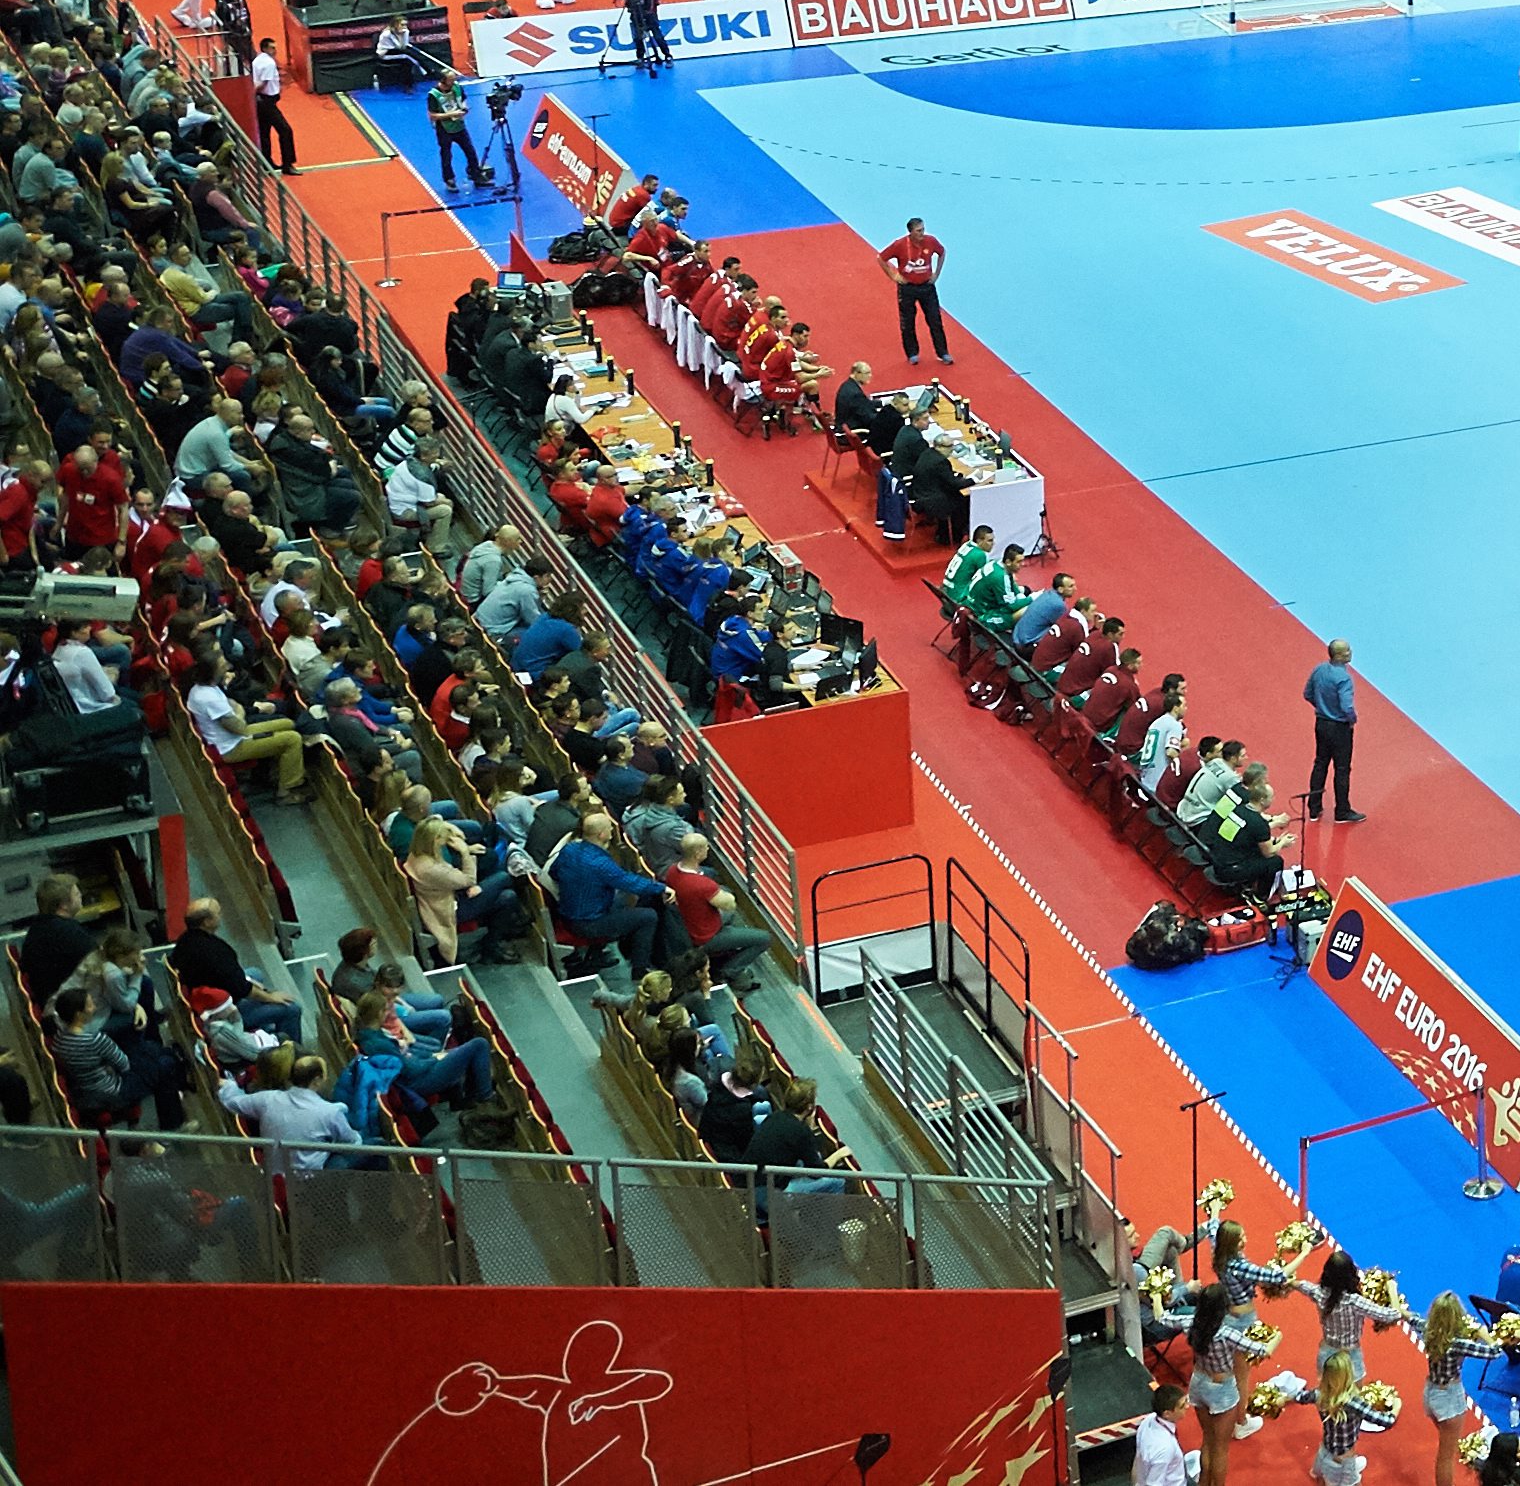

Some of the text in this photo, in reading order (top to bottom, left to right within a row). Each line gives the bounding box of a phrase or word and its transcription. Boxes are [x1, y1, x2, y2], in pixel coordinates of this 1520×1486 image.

[568, 10, 771, 54] SUZUKI
[1245, 217, 1431, 293] VELUX
[1332, 930, 1361, 952] EHF
[1361, 952, 1489, 1091] EHF EURO 2016
